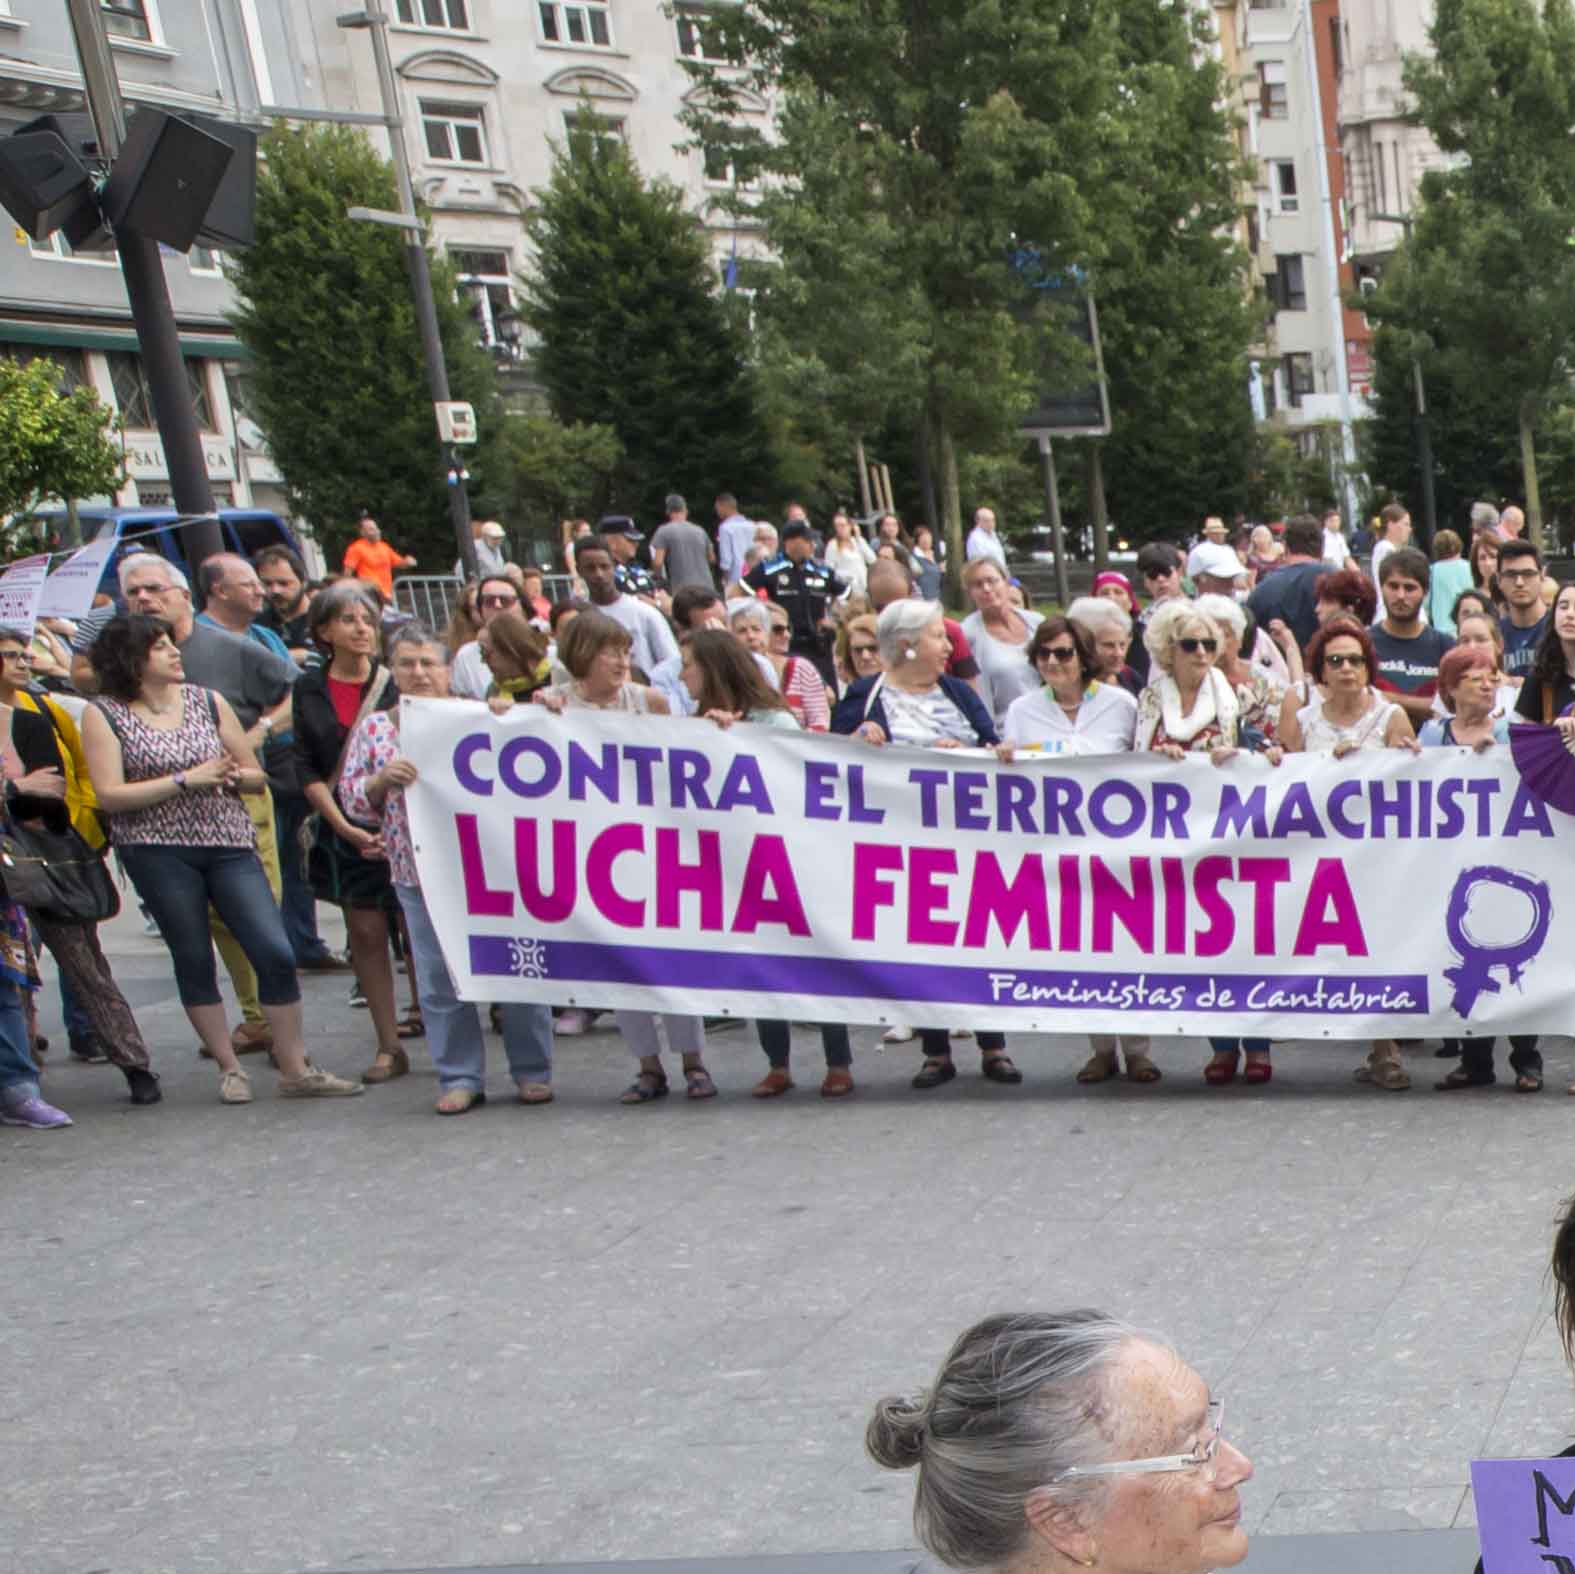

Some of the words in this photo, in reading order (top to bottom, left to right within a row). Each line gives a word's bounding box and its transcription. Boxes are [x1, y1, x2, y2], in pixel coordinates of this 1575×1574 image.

[452, 732, 775, 815] CONTRA
[804, 761, 886, 824] EL
[908, 768, 1191, 839] TERROR
[1211, 777, 1555, 839] MACHISTA
[454, 813, 812, 937] LUCHA
[851, 842, 1369, 958] FEMINISTA
[989, 972, 1183, 1010] Feministas
[1196, 977, 1235, 1008] de
[1246, 977, 1417, 1013] Cantabria
